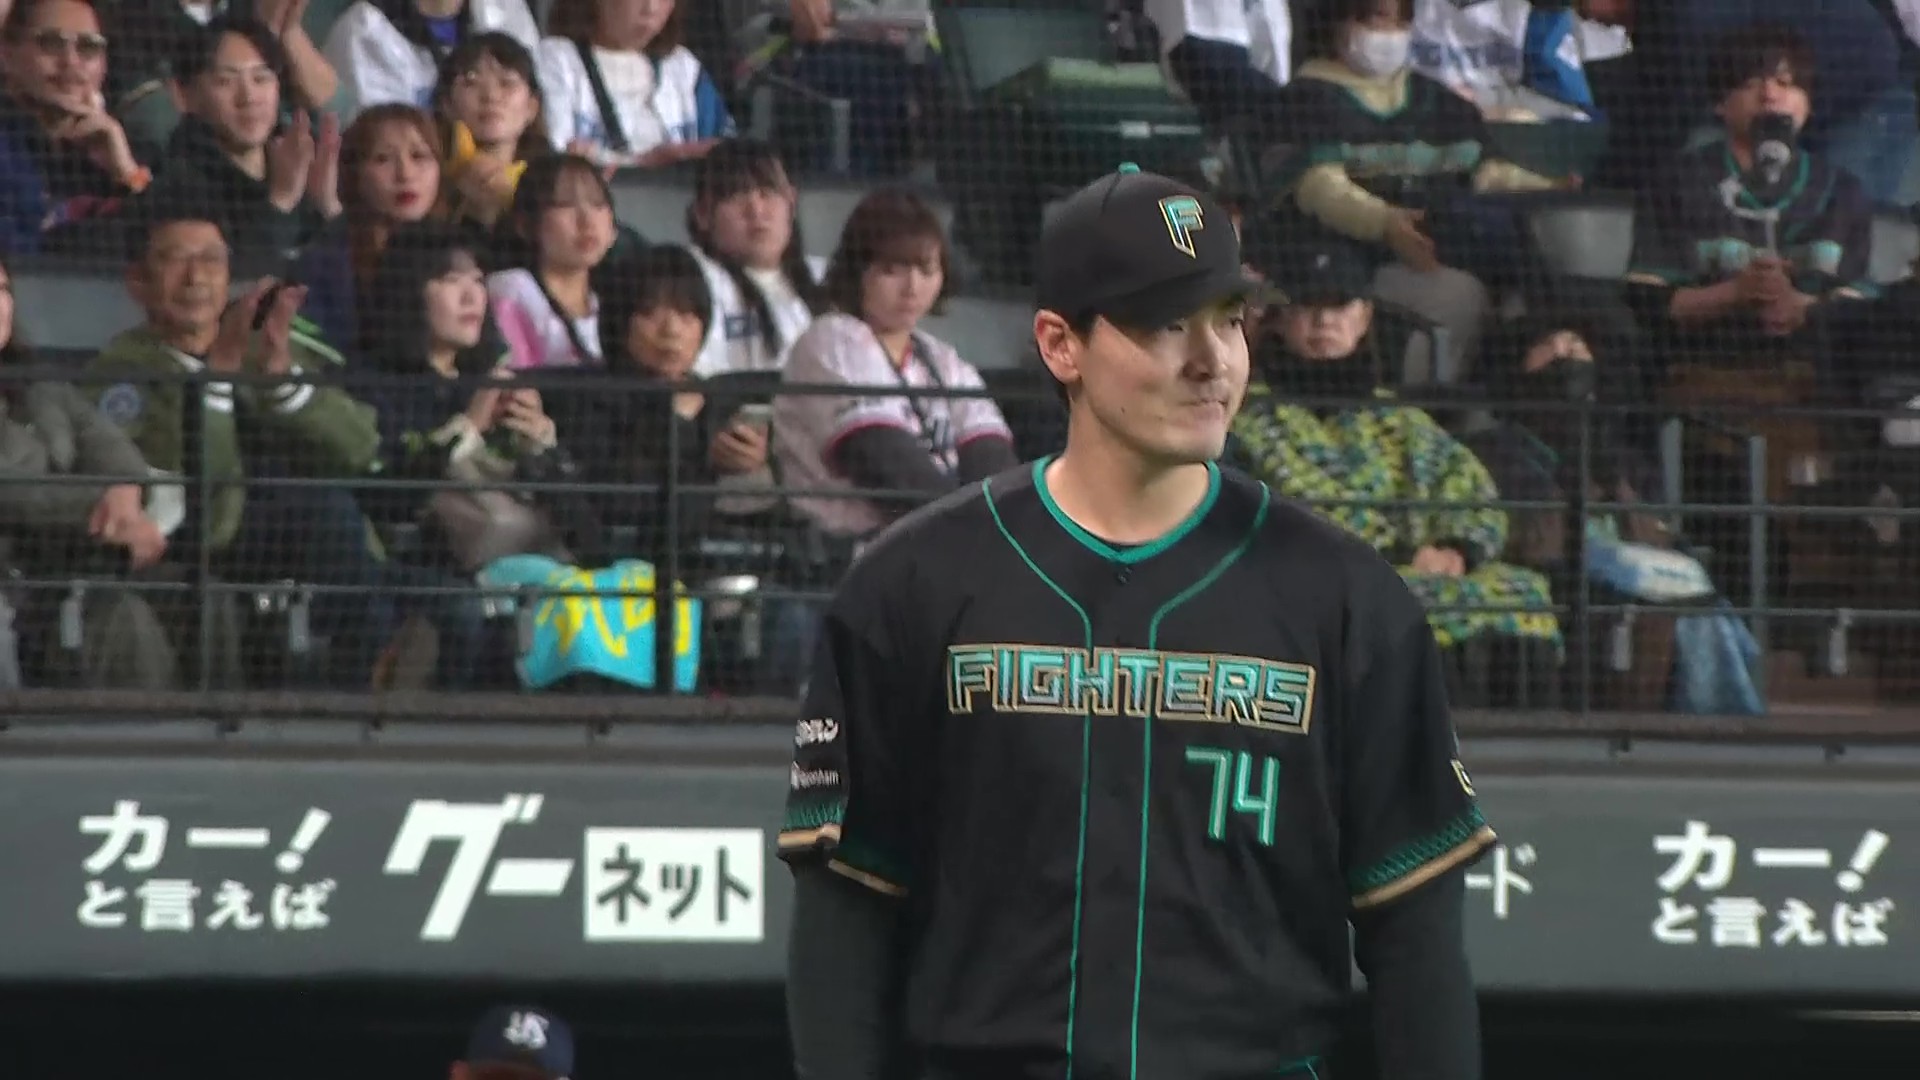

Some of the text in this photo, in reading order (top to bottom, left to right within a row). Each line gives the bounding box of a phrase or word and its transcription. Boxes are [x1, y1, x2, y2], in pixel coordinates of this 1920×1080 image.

[1158, 195, 1204, 259] F
[948, 643, 1317, 735] FIGHTERS
[1185, 745, 1280, 847] 74
[77, 878, 338, 932] と言えば
[1652, 897, 1896, 948] と言えば
